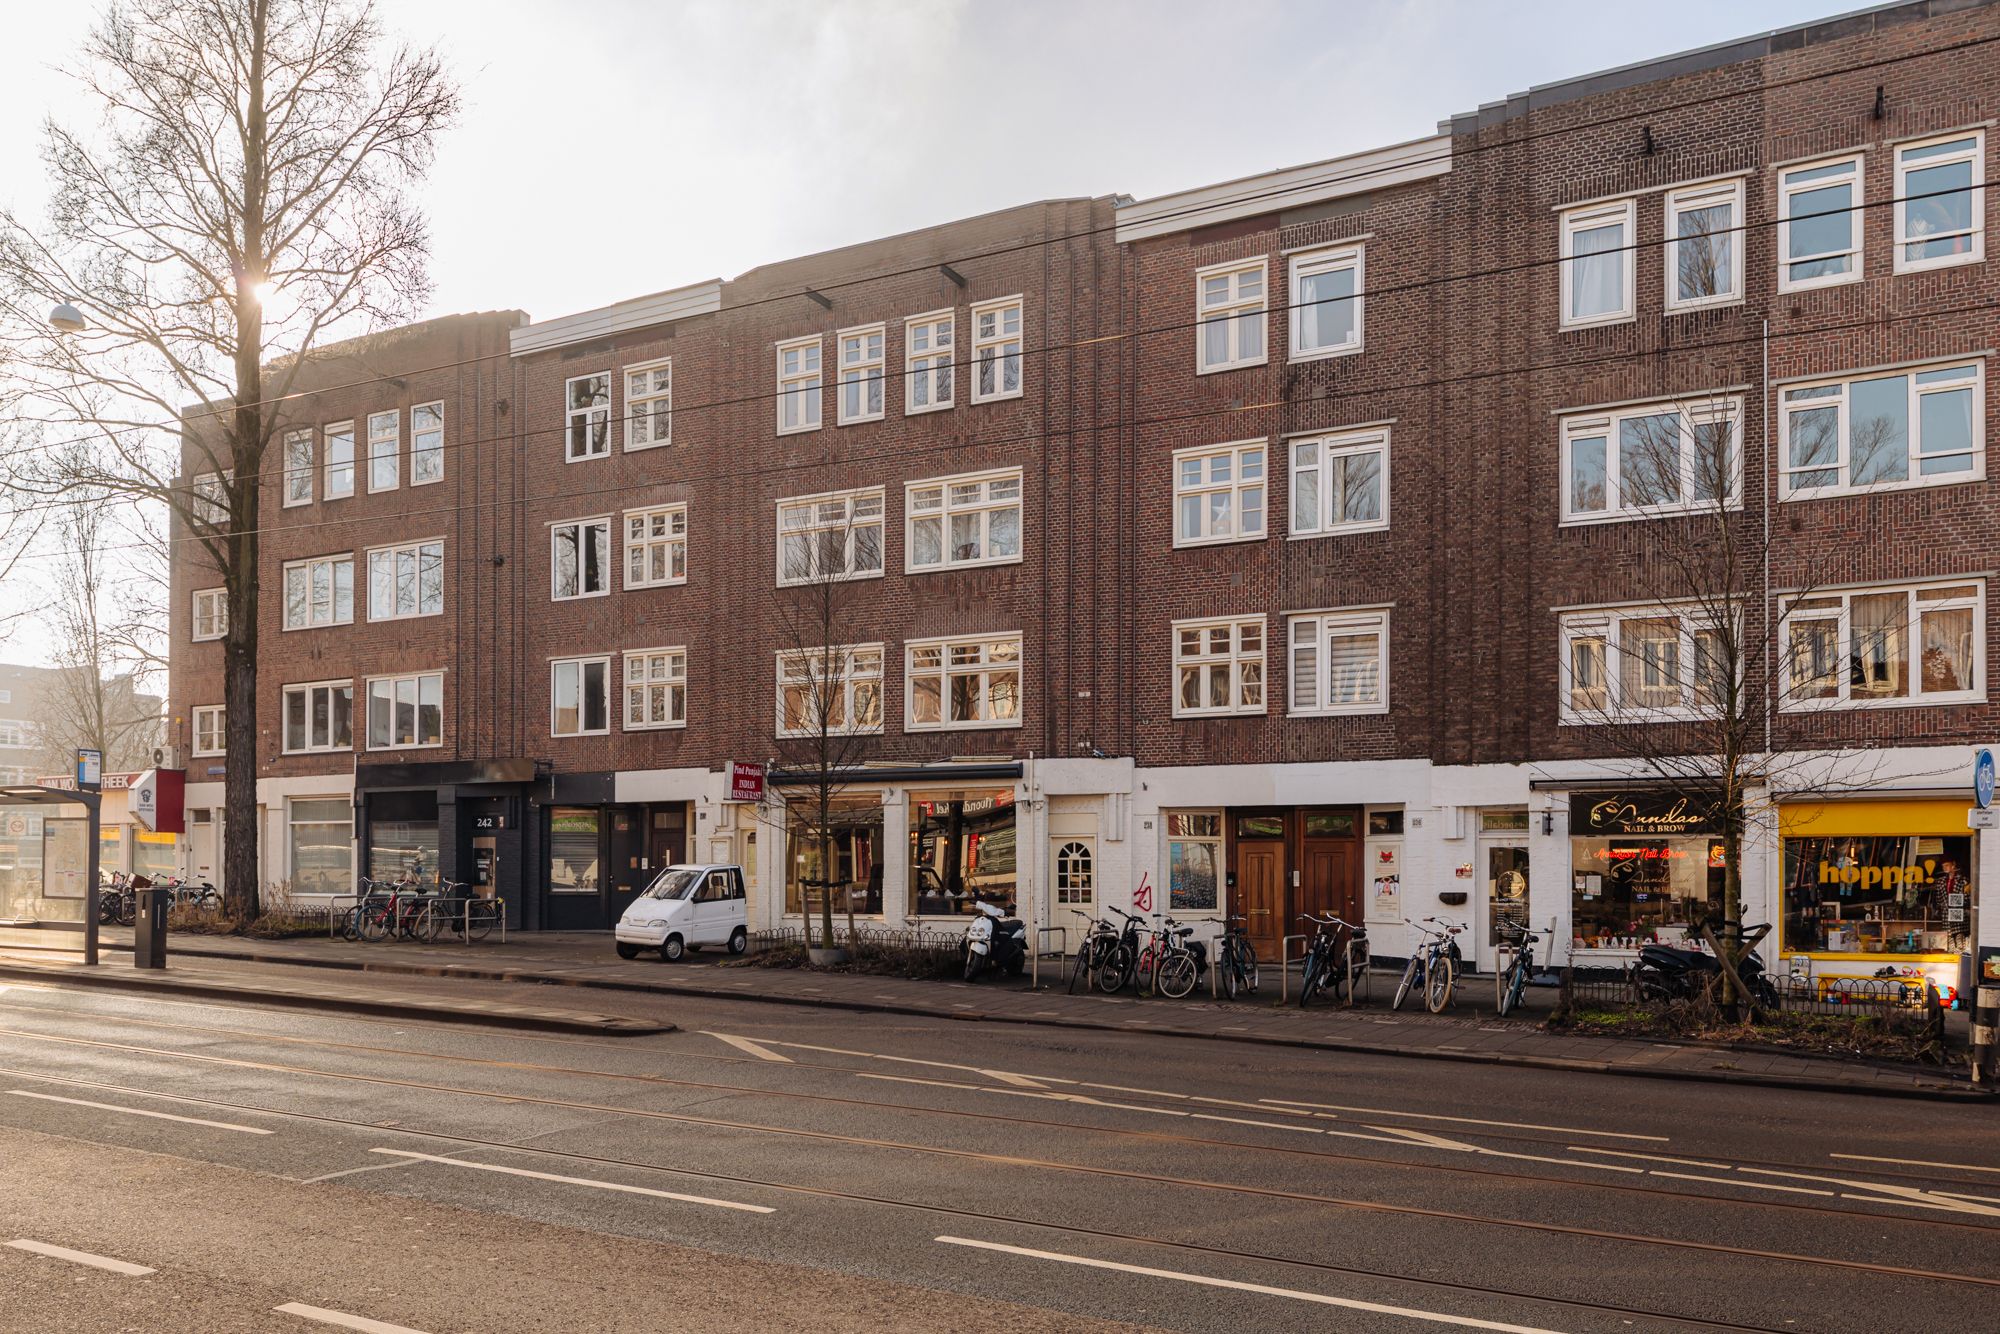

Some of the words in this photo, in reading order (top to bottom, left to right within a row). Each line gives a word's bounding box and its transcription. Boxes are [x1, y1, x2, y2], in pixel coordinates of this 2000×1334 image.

[745, 766, 763, 778] Punjabi
[101, 775, 129, 789] THEEK
[738, 779, 756, 789] INDIAN
[732, 789, 762, 800] RESTAURANT
[477, 818, 493, 828] 242
[1623, 824, 1647, 834] NAIL
[1648, 824, 1656, 833] &
[1657, 823, 1686, 833] BROW
[1819, 859, 1937, 890] hoppa!
